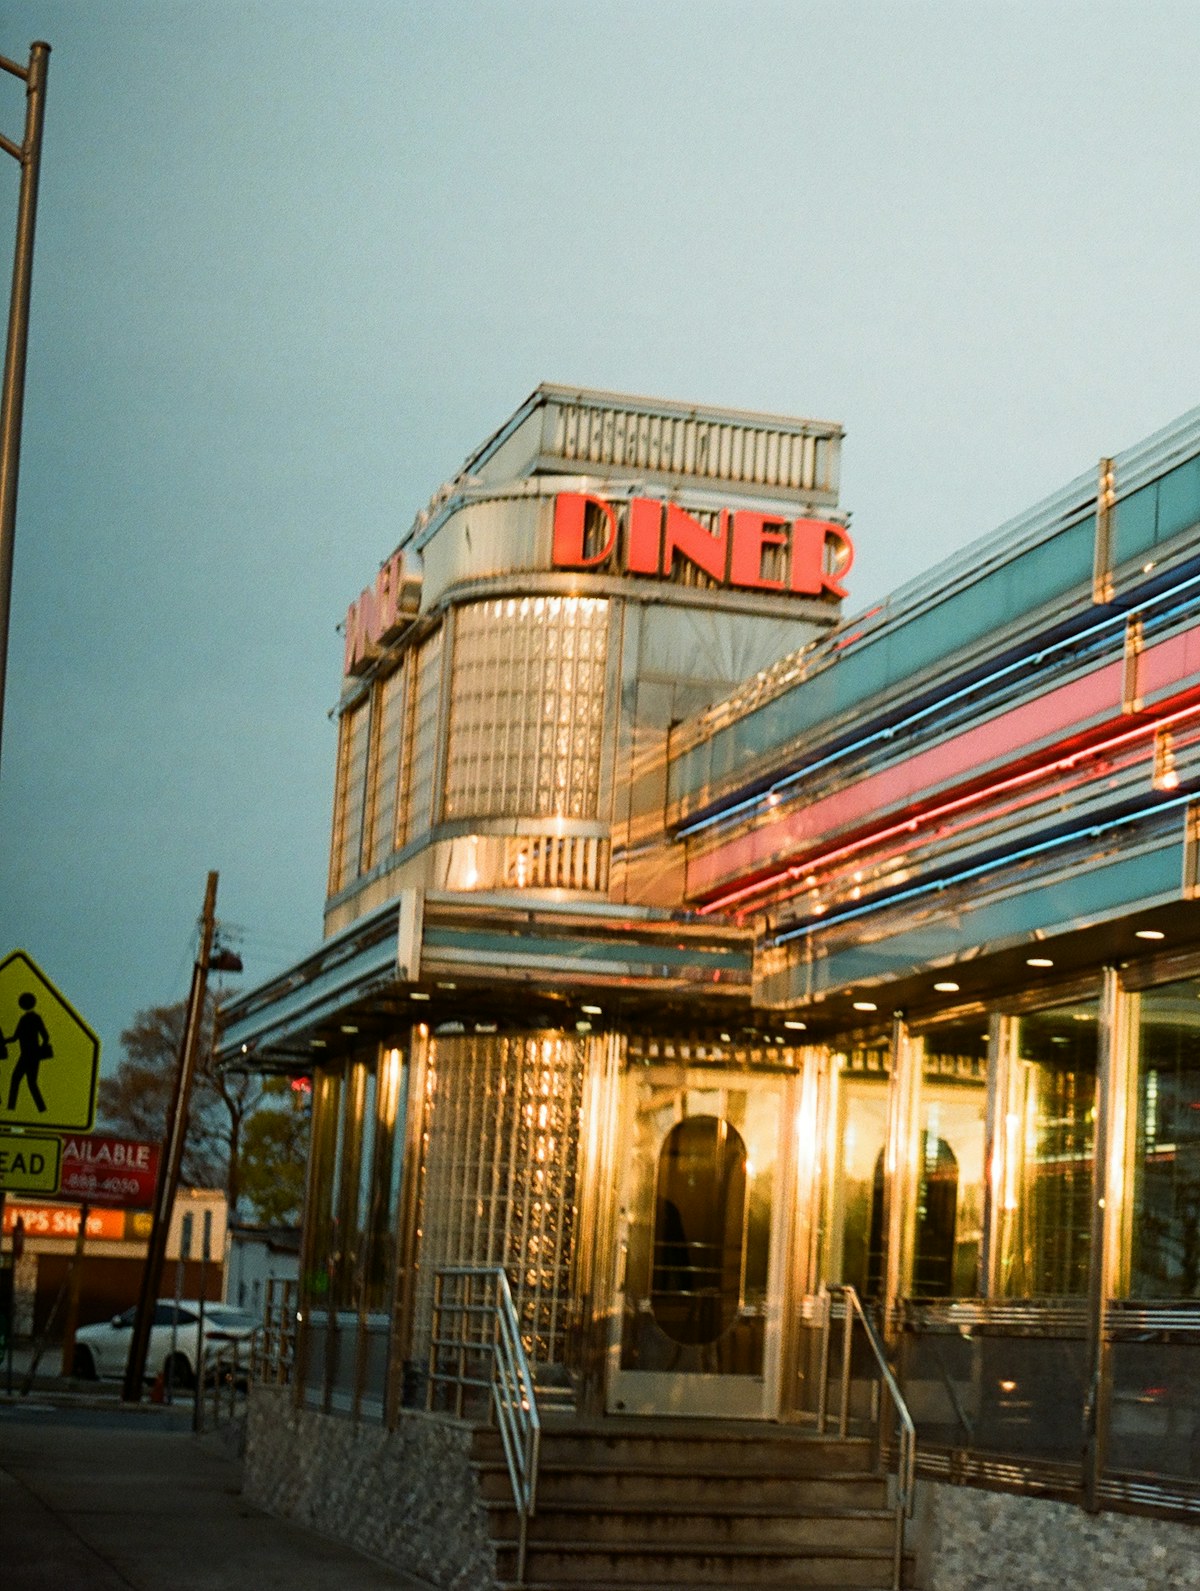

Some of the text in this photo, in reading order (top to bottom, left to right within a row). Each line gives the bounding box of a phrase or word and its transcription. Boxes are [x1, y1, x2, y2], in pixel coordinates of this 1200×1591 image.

[552, 491, 855, 598] DINER
[0, 1151, 46, 1176] EAD
[53, 1211, 103, 1234] Stoe
